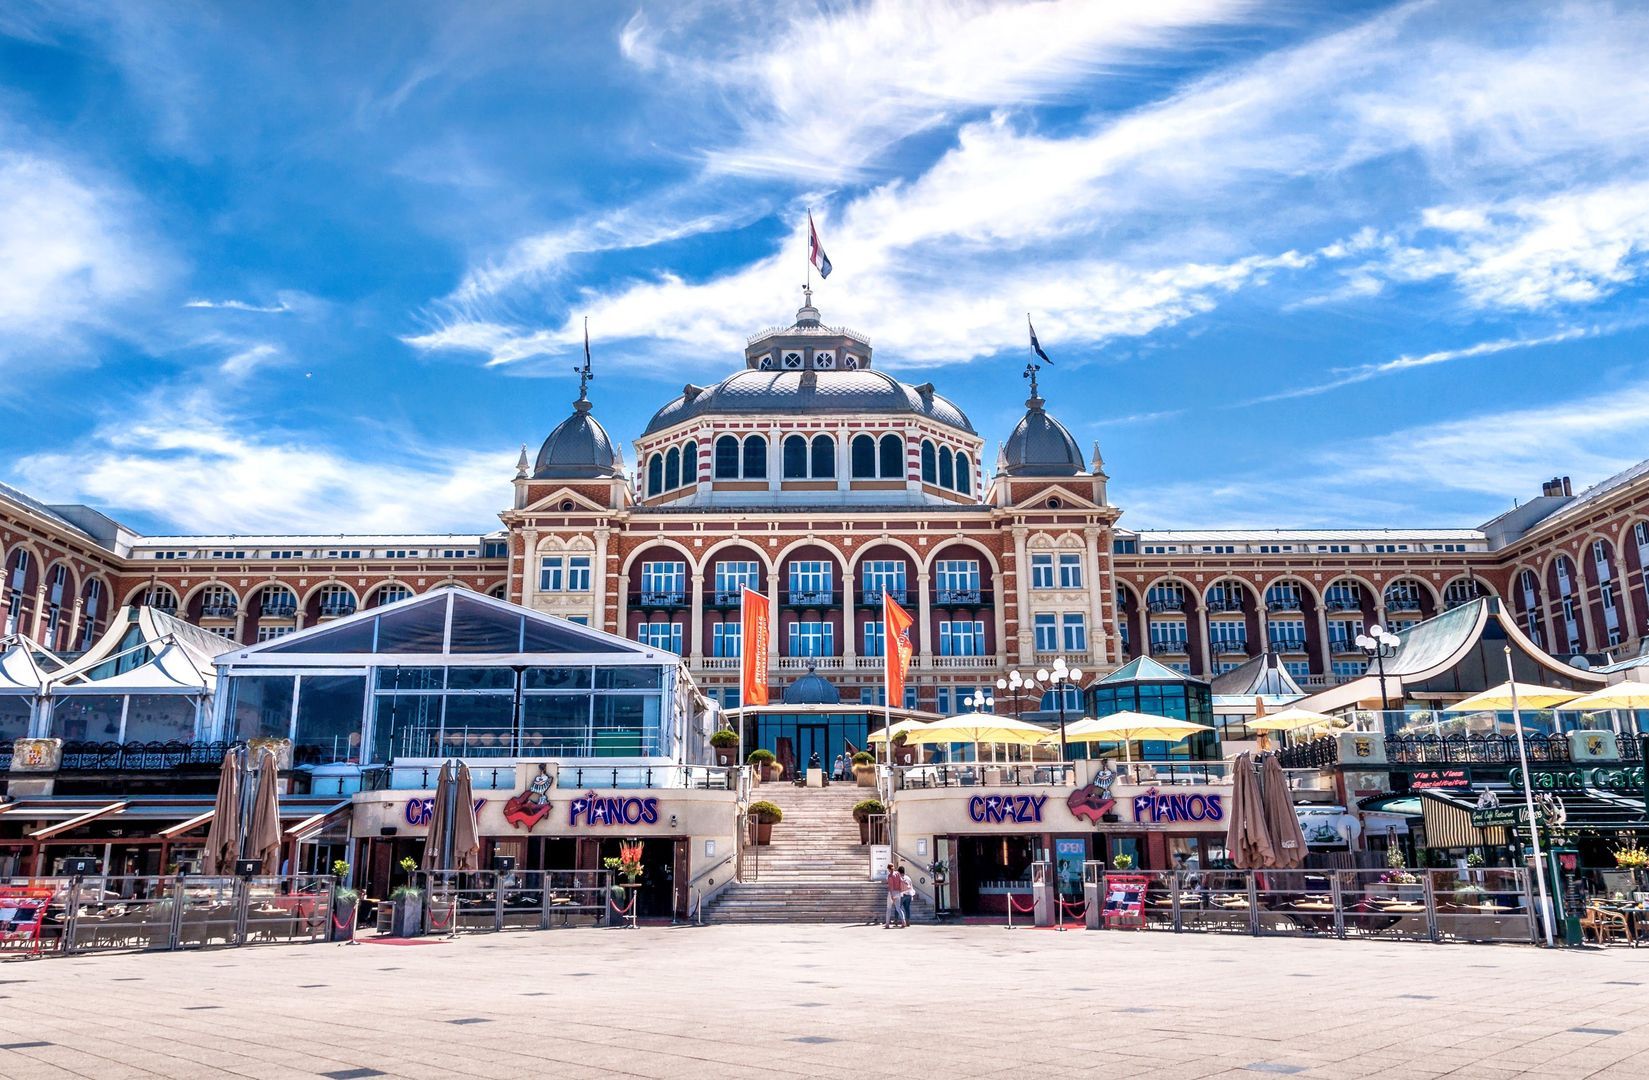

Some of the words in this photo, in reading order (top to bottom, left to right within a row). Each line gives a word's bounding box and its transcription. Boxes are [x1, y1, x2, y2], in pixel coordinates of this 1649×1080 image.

[1508, 767, 1584, 789] Grand
[968, 794, 1049, 824] CRAZY
[1059, 842, 1083, 854] OPEN
